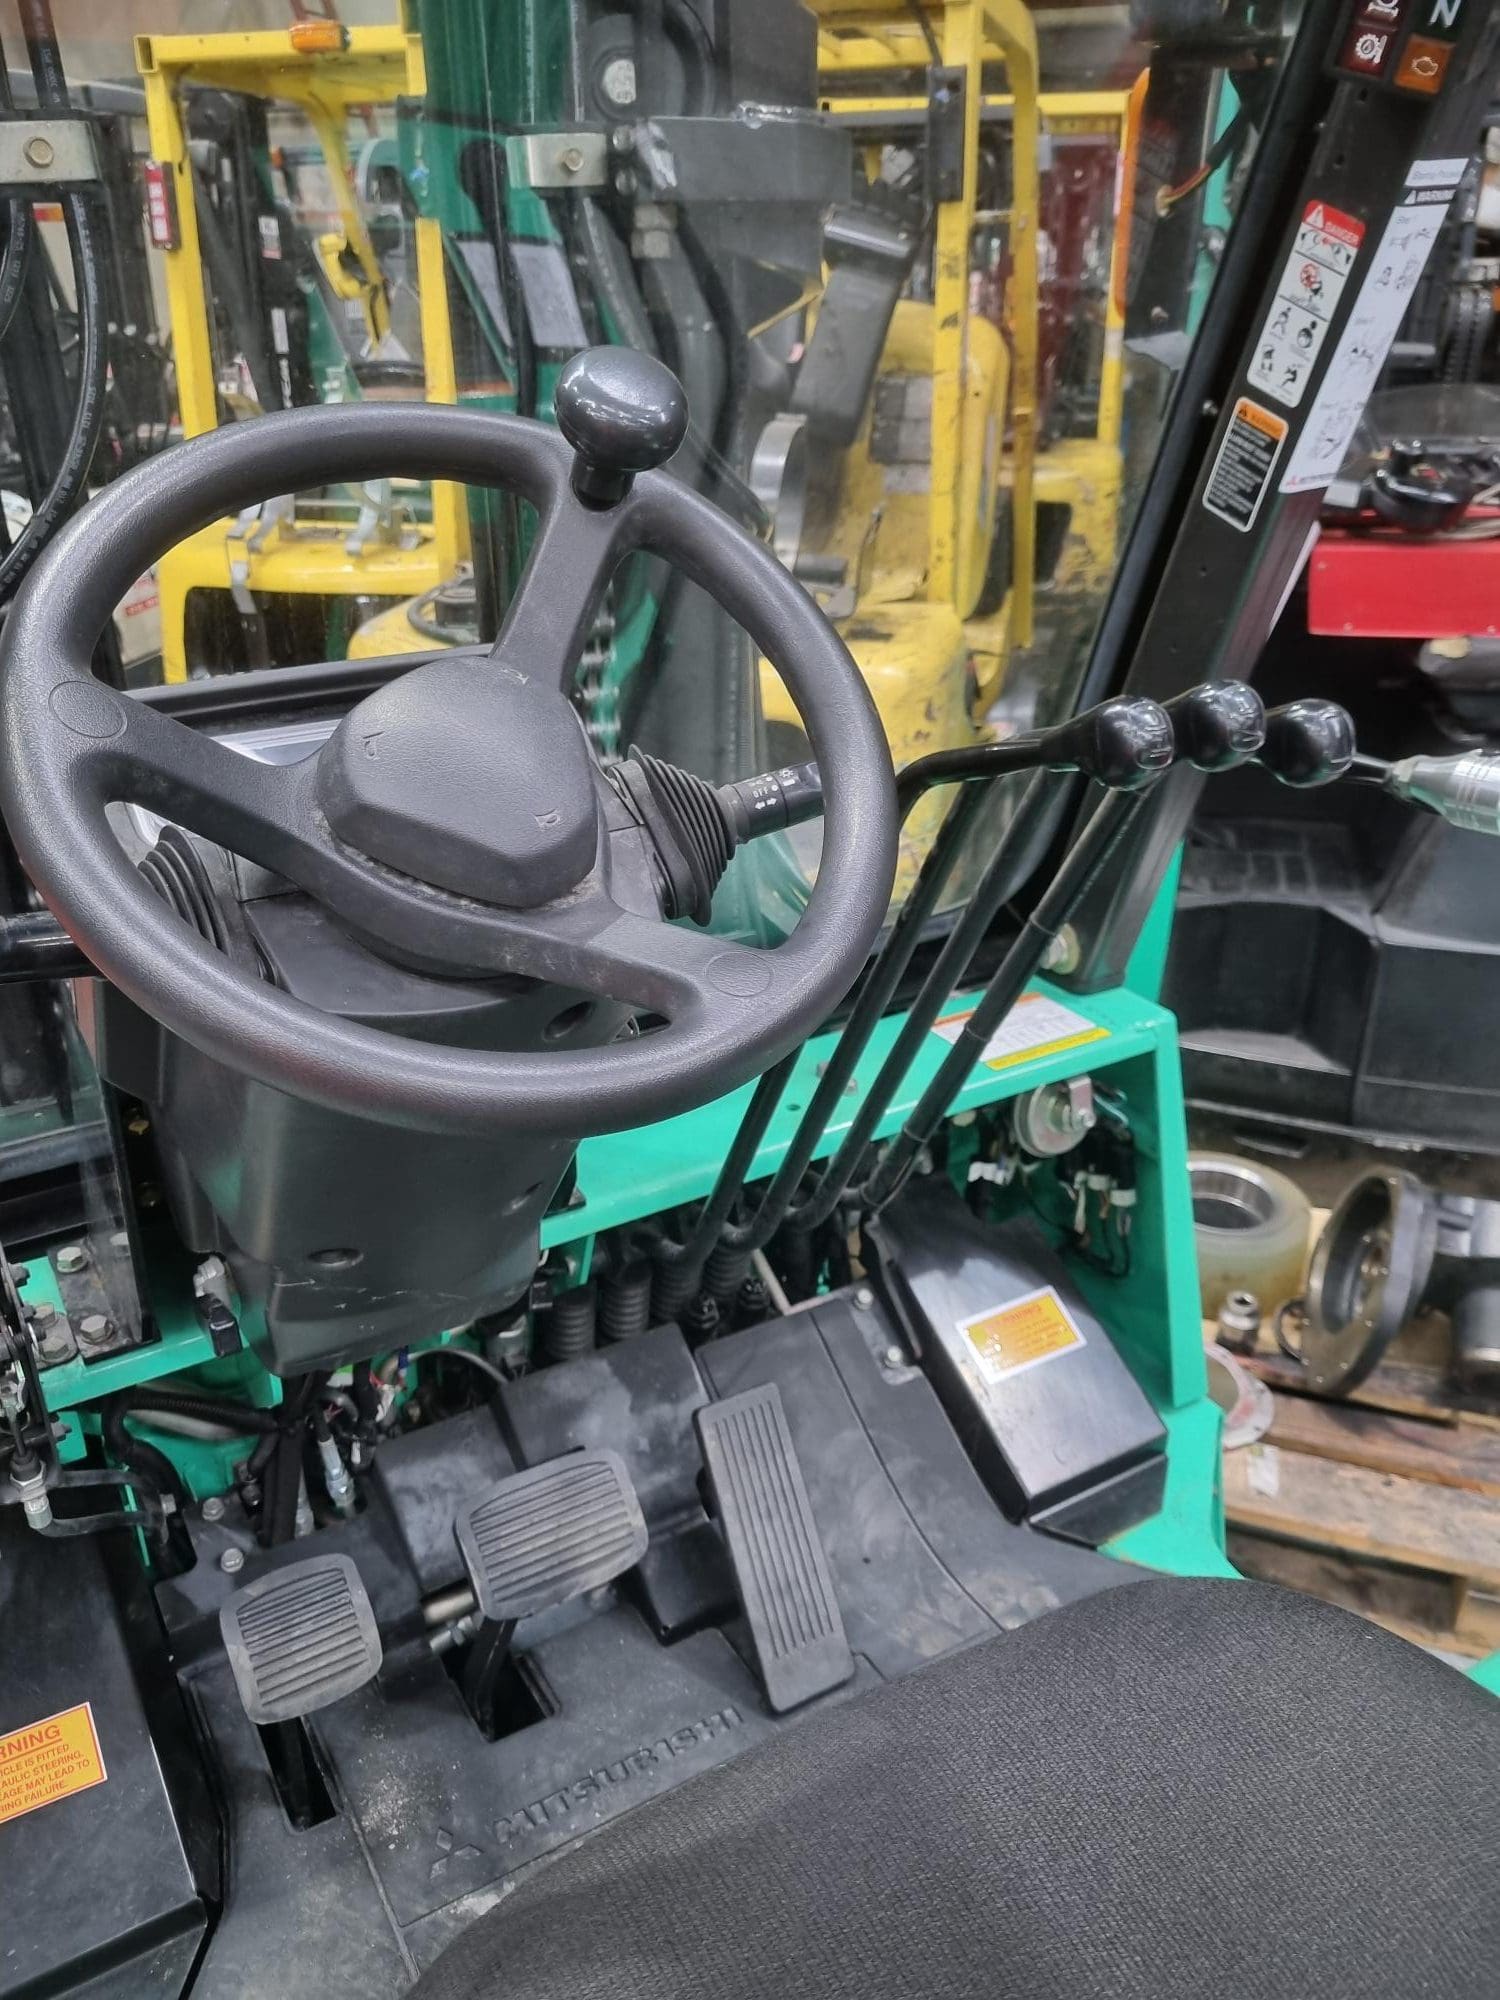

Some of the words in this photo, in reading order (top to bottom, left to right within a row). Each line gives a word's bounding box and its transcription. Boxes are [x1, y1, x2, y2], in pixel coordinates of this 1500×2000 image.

[1428, 0, 1462, 28] N
[25, 1759, 34, 1769] IS
[37, 1744, 70, 1761] FITTED
[26, 1776, 46, 1790] MAY
[49, 1764, 74, 1781] LEAD
[78, 1759, 90, 1771] TO
[495, 1706, 744, 1844] MITSUBISHI
